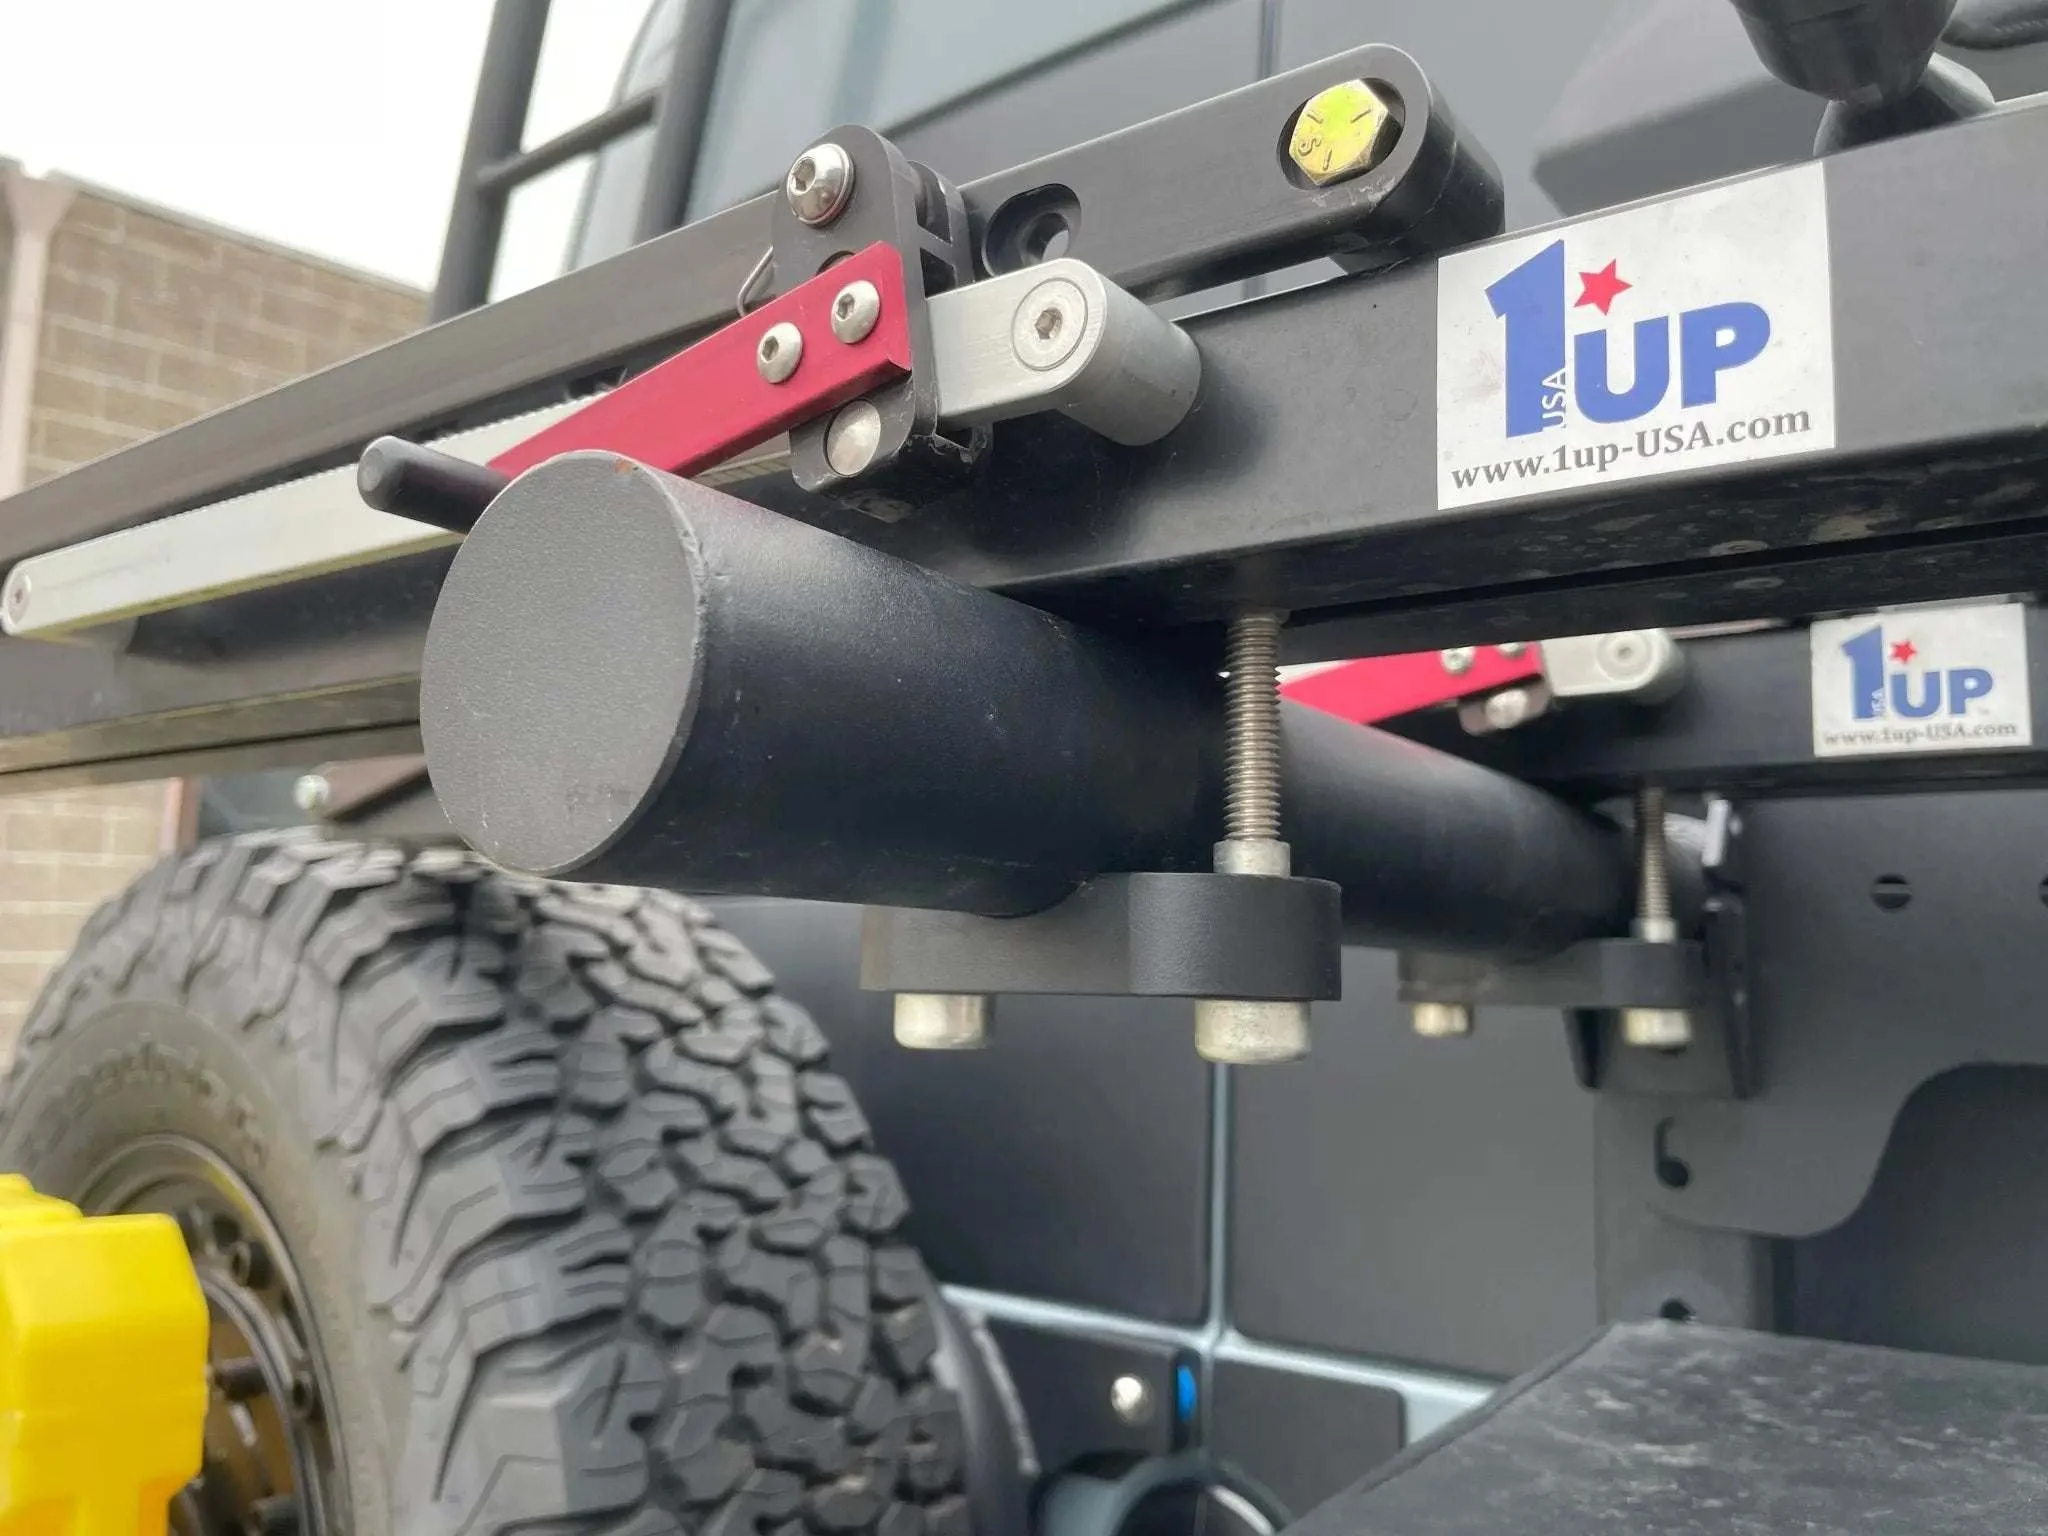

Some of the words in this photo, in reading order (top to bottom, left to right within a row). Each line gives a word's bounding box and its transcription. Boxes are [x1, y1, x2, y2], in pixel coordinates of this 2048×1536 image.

[1541, 368, 1567, 430] USA
[1450, 408, 1812, 490] www.1up-USA.com
[1824, 722, 2018, 746] www.1up-USA.com
